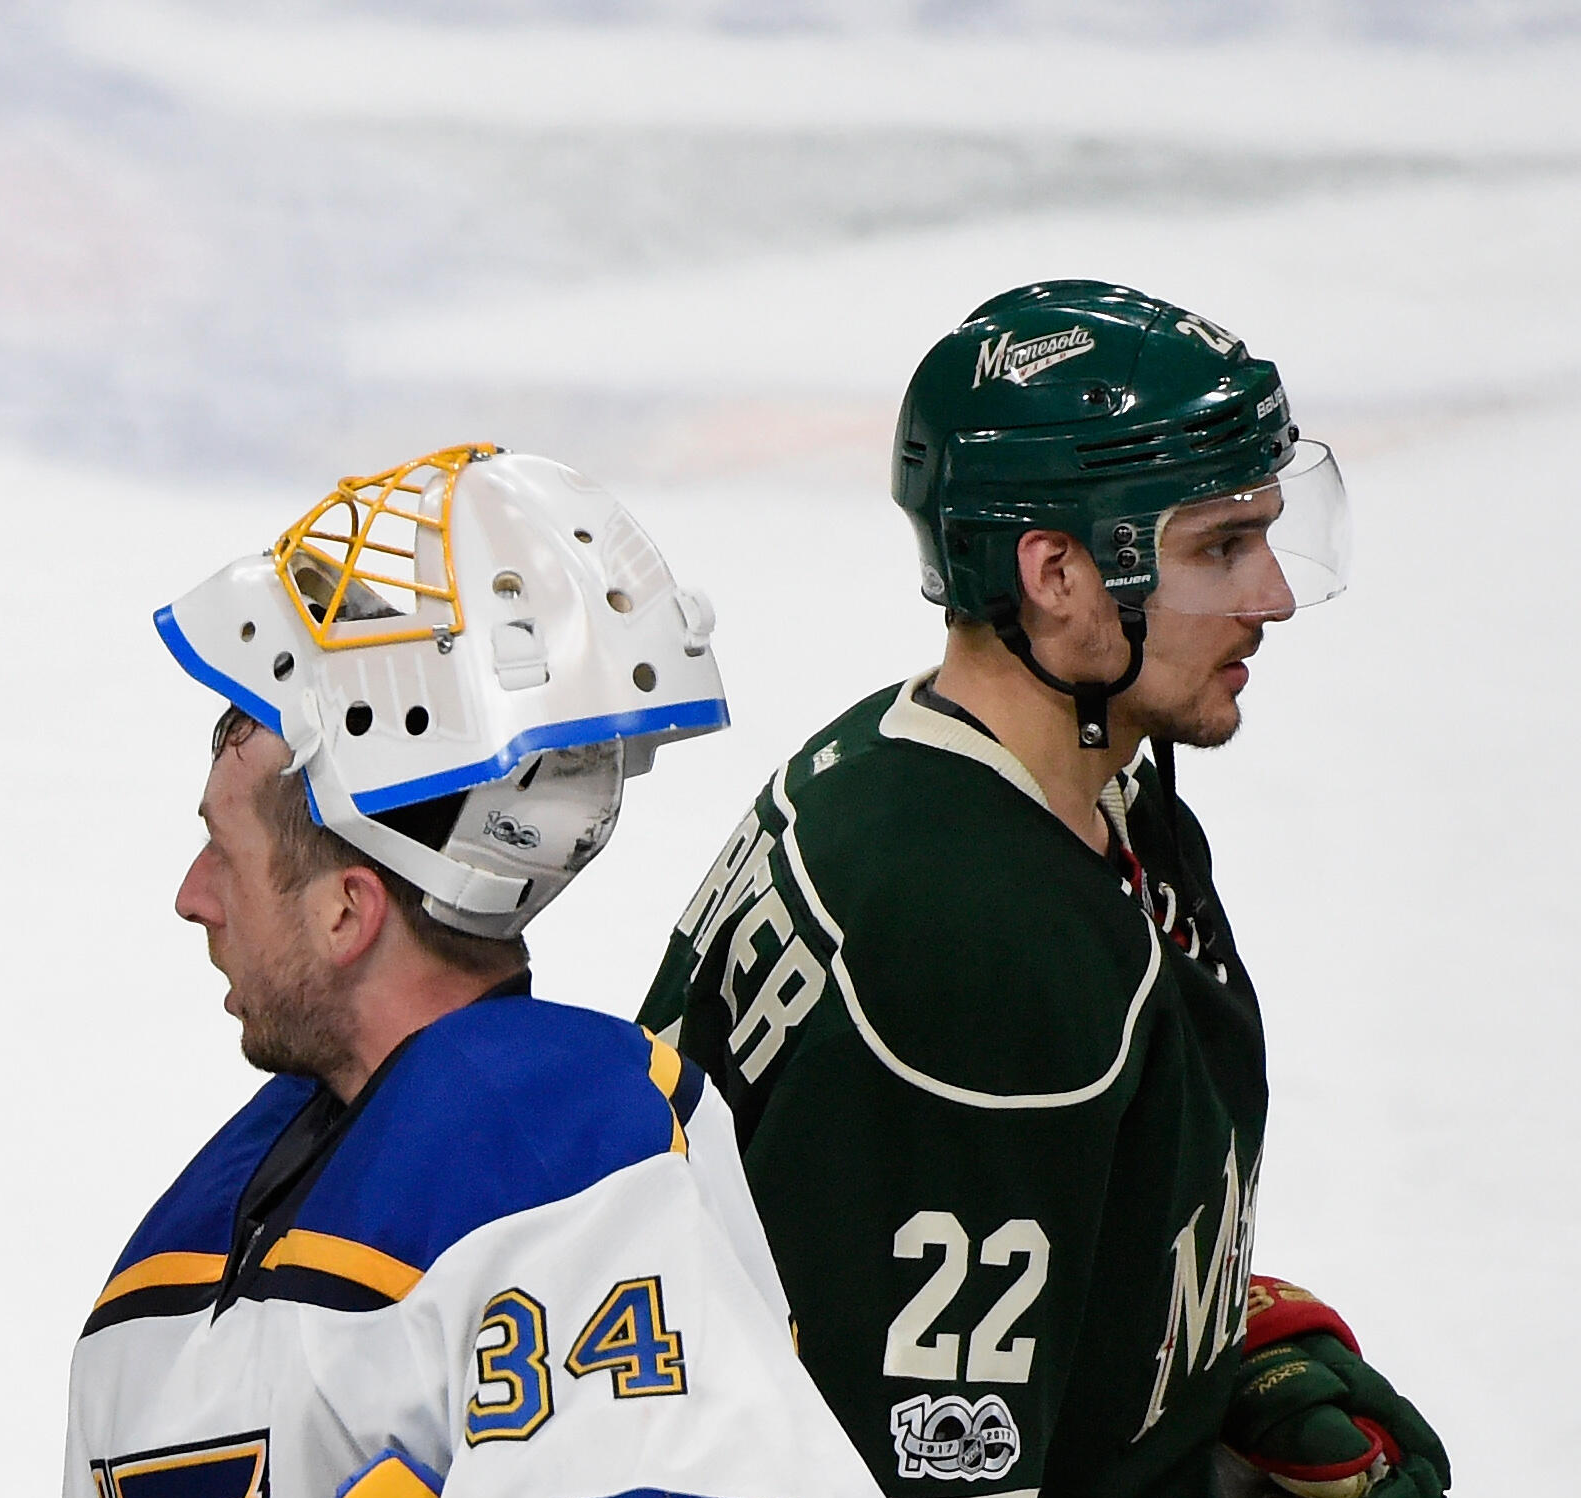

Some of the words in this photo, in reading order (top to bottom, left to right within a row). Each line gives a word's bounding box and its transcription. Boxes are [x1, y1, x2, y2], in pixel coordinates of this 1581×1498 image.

[971, 325, 1092, 389] Minnesota
[1105, 574, 1152, 588] BAUER
[883, 1211, 1050, 1383] 22
[467, 1276, 688, 1447] 34
